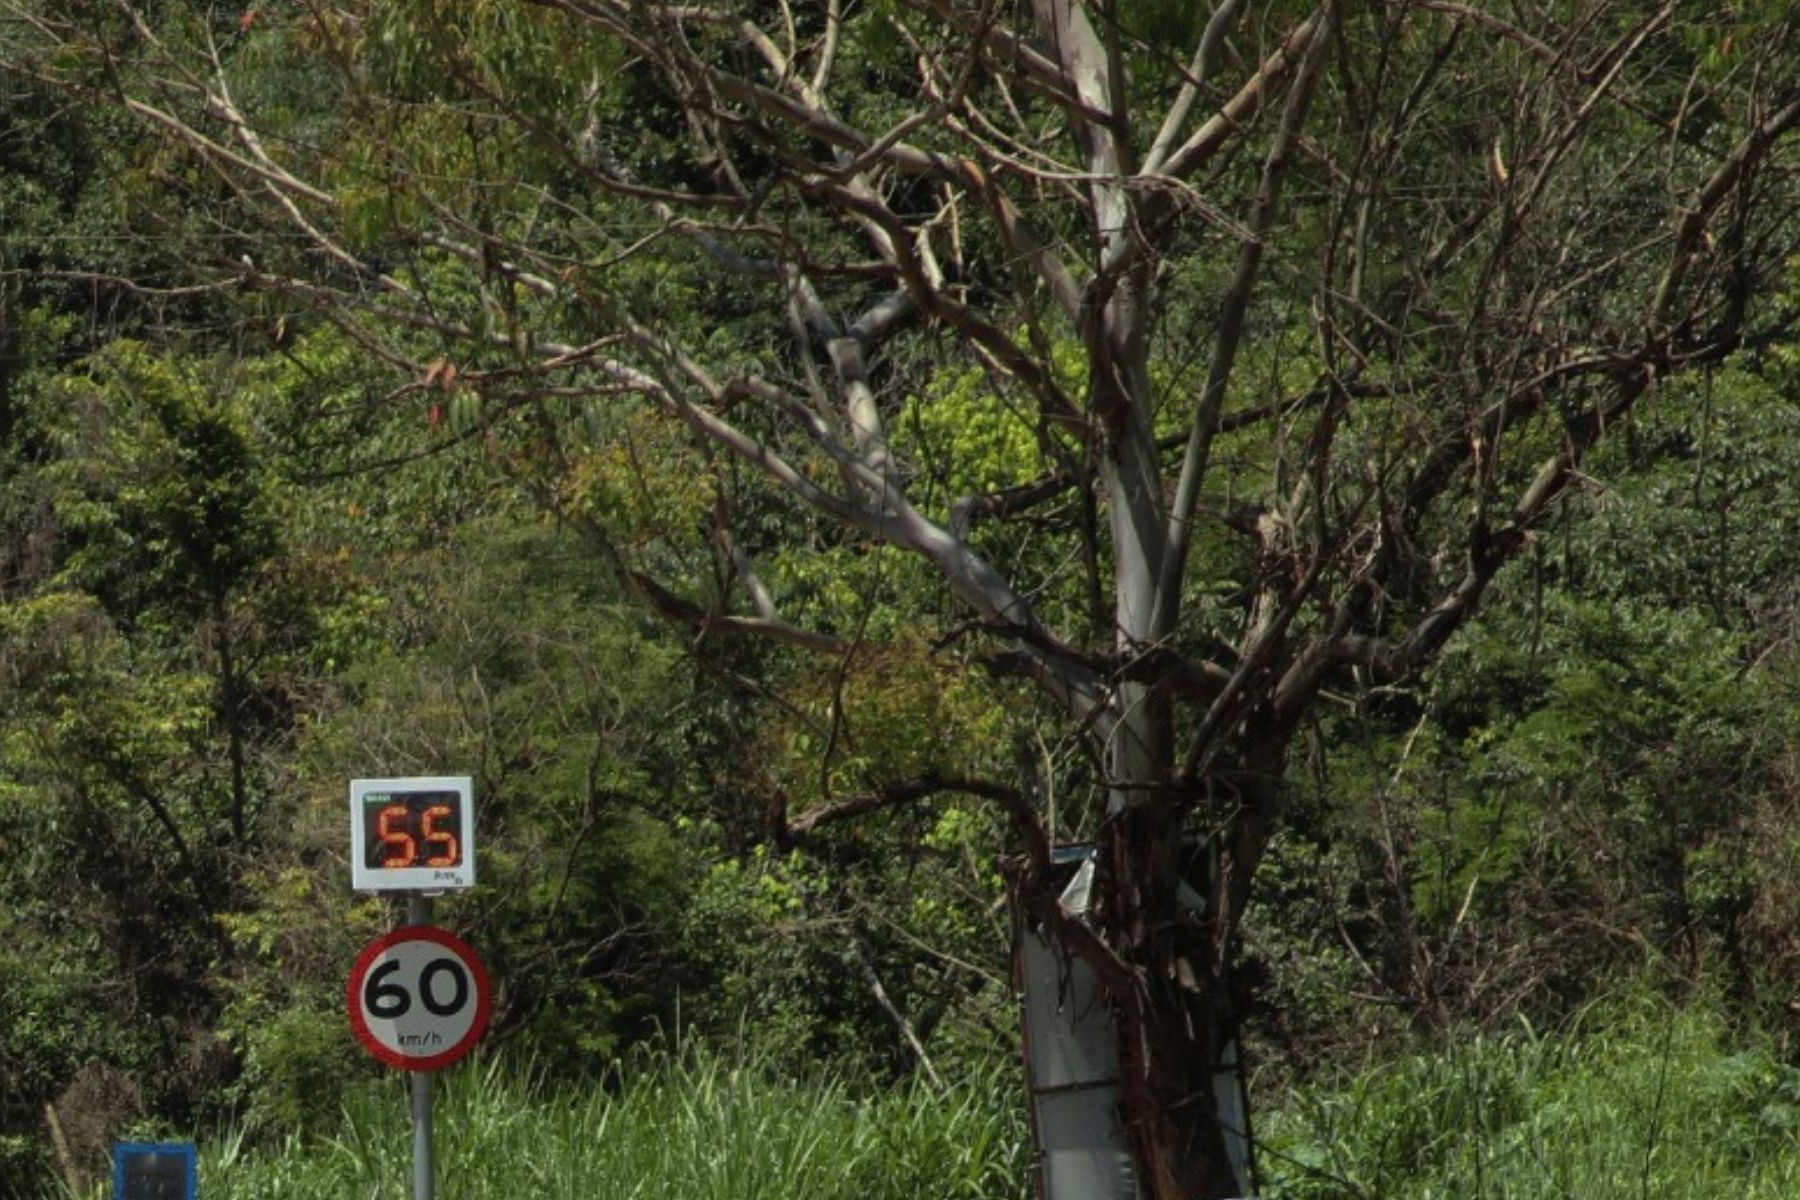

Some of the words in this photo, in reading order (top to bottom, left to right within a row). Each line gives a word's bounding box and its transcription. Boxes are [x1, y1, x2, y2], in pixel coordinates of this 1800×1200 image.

[378, 805, 457, 868] 55
[365, 958, 469, 1019] 60
[397, 1031, 442, 1046] km/h
